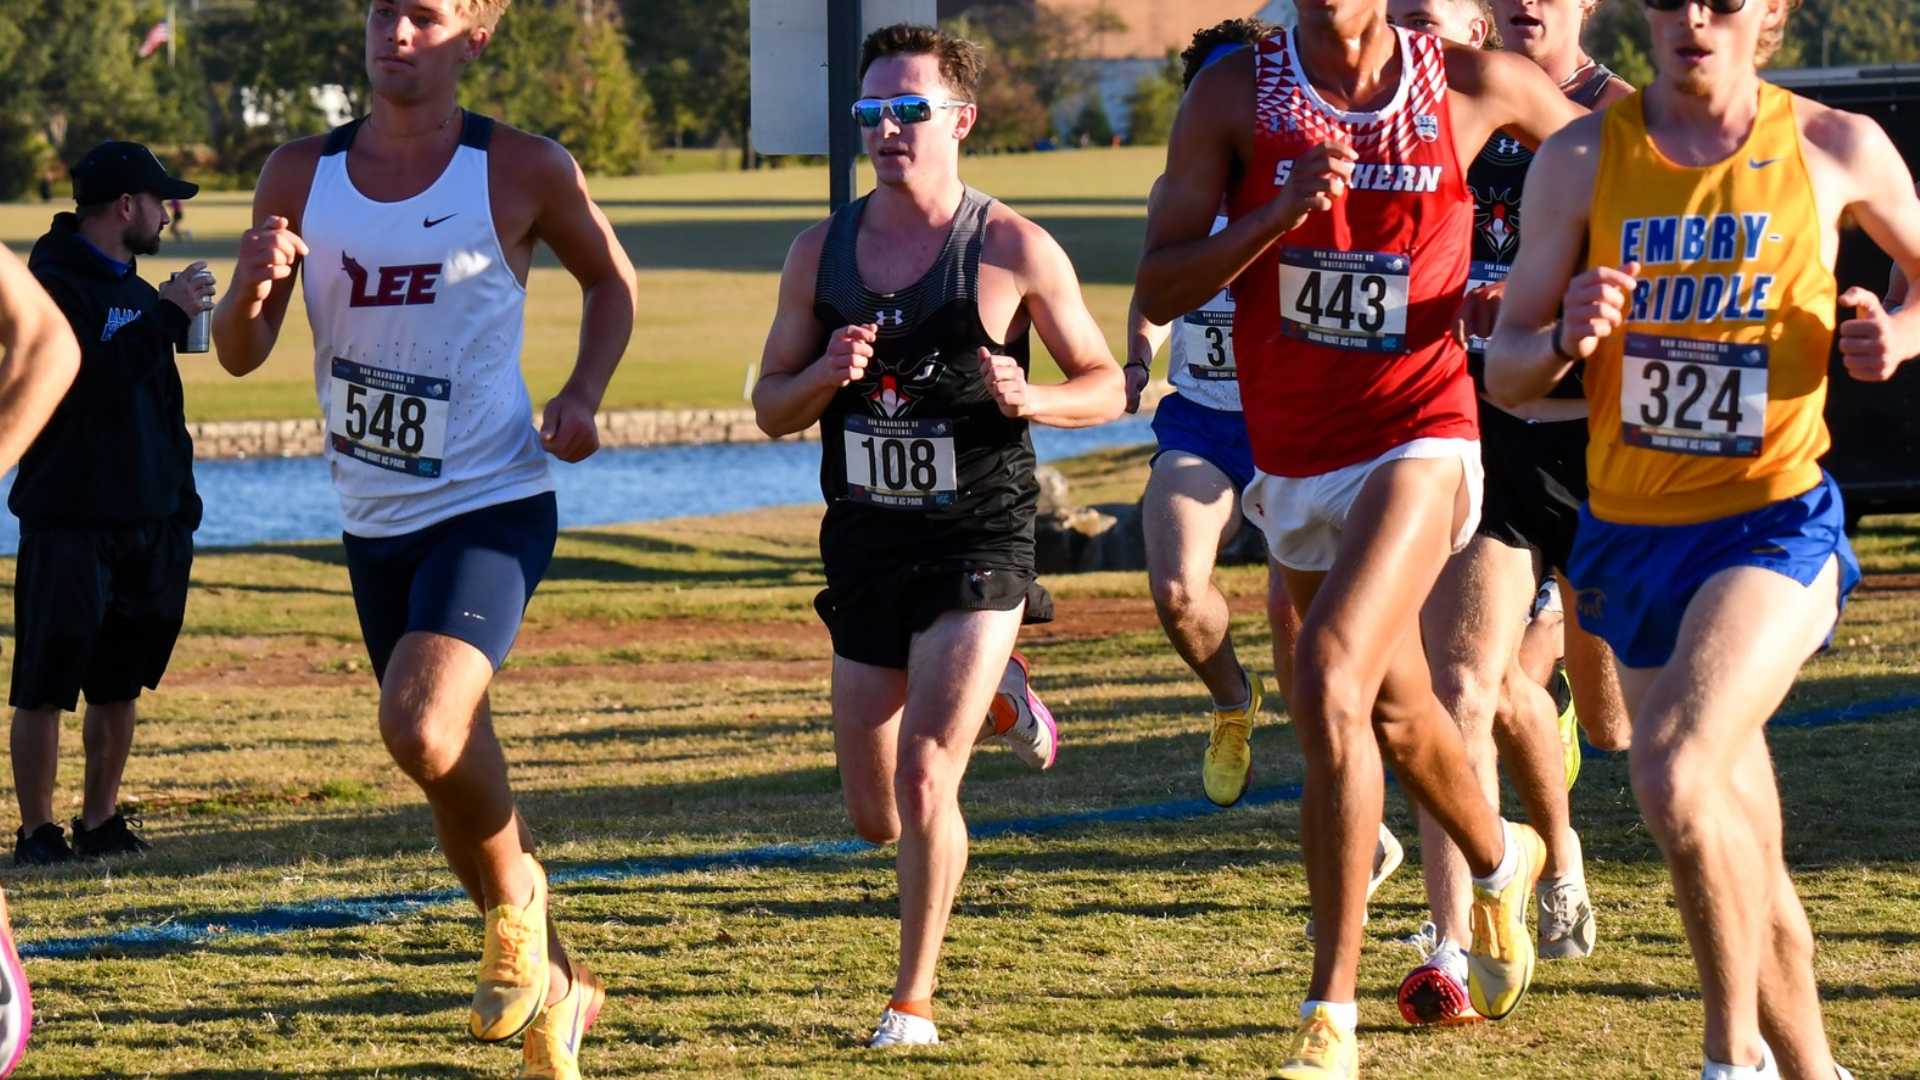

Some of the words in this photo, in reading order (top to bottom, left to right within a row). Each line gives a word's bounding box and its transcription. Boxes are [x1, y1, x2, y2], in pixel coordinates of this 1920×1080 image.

[1272, 159, 1443, 192] SHERN
[1621, 212, 1783, 266] EMBRY-
[341, 249, 443, 308] LEE
[1321, 260, 1366, 270] INVITATIONAL
[1295, 271, 1387, 332] 443
[1625, 273, 1776, 323] RIDDLE
[373, 369, 405, 382] CHARGERS
[1668, 349, 1719, 362] INVITATIONAL
[365, 376, 407, 392] INVITATIONAL
[1641, 361, 1743, 433] 324
[345, 383, 427, 454] 548
[874, 427, 913, 435] INVITATIONAL
[861, 437, 937, 490] 108
